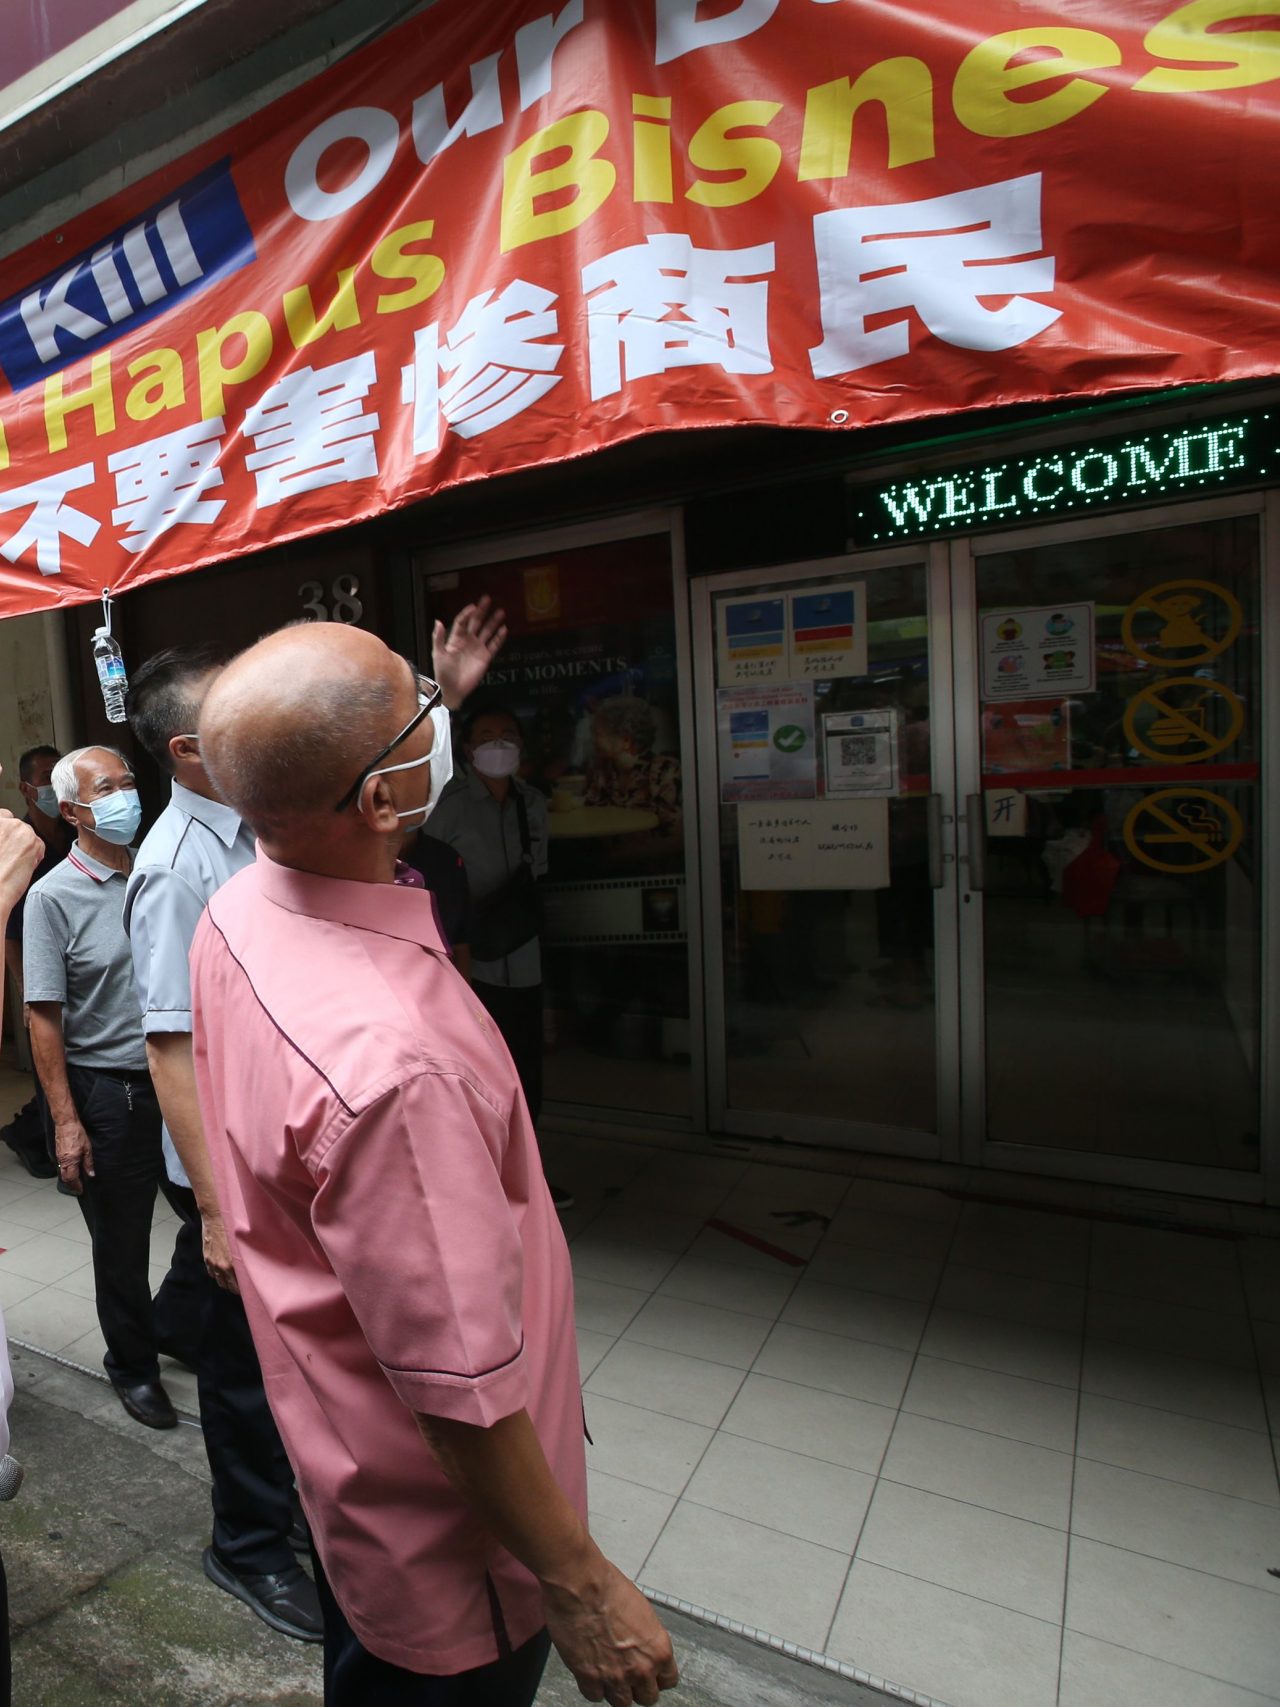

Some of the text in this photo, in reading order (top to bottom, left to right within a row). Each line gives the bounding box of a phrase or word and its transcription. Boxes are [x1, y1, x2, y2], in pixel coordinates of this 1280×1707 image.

[19, 200, 205, 363] Kill
[284, 0, 583, 221] Our
[44, 219, 446, 454] Hapus
[499, 0, 1280, 255] Bisnes
[880, 426, 1245, 526] WELCOME
[298, 574, 363, 624] 38
